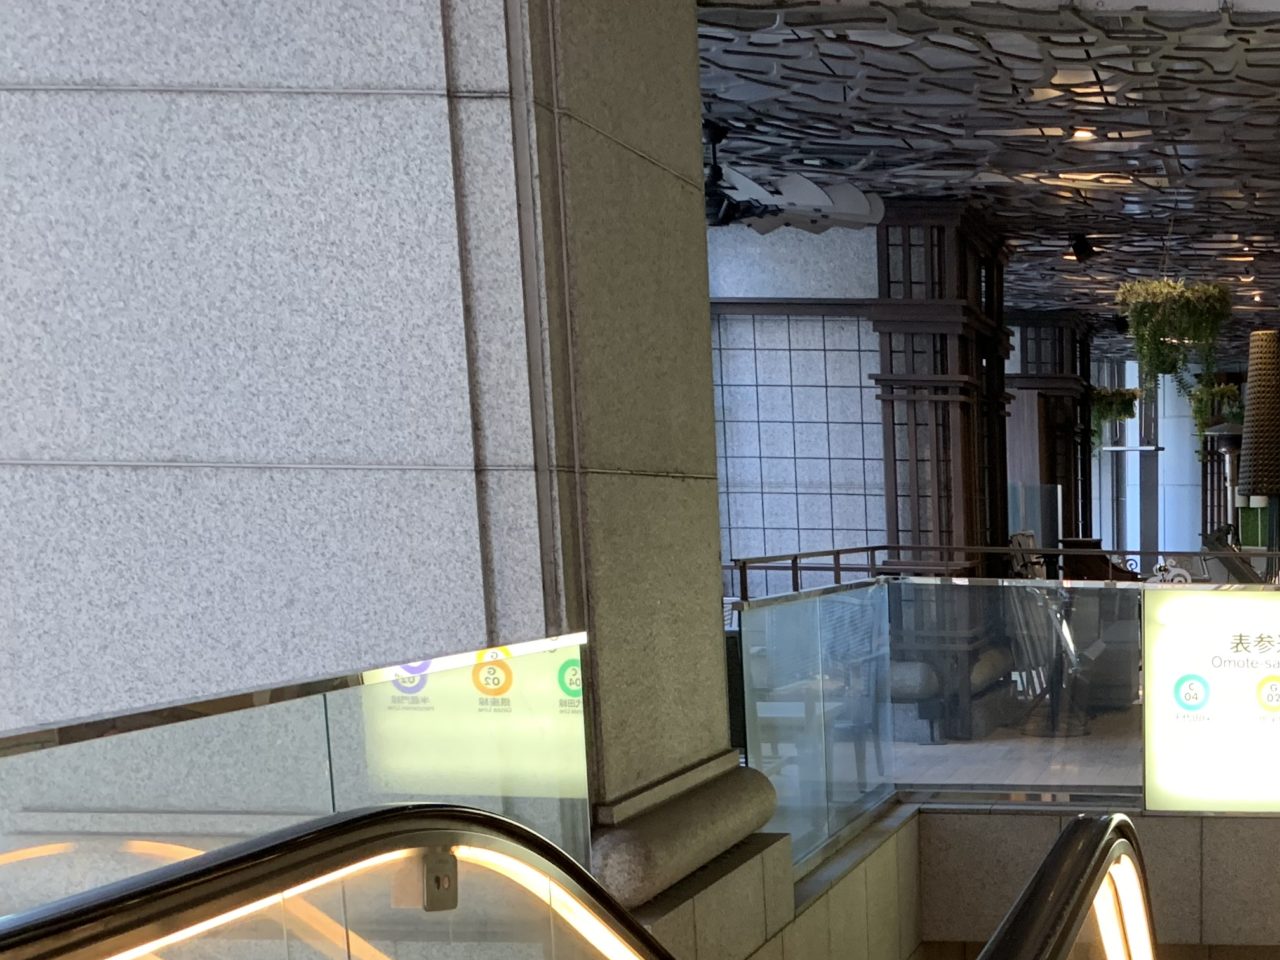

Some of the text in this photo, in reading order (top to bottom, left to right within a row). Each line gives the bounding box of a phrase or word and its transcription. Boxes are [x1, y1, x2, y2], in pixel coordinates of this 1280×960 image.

[1188, 683, 1195, 691] C
[1270, 684, 1278, 693] G
[1184, 693, 1199, 702] 04
[1266, 694, 1280, 703] 02
